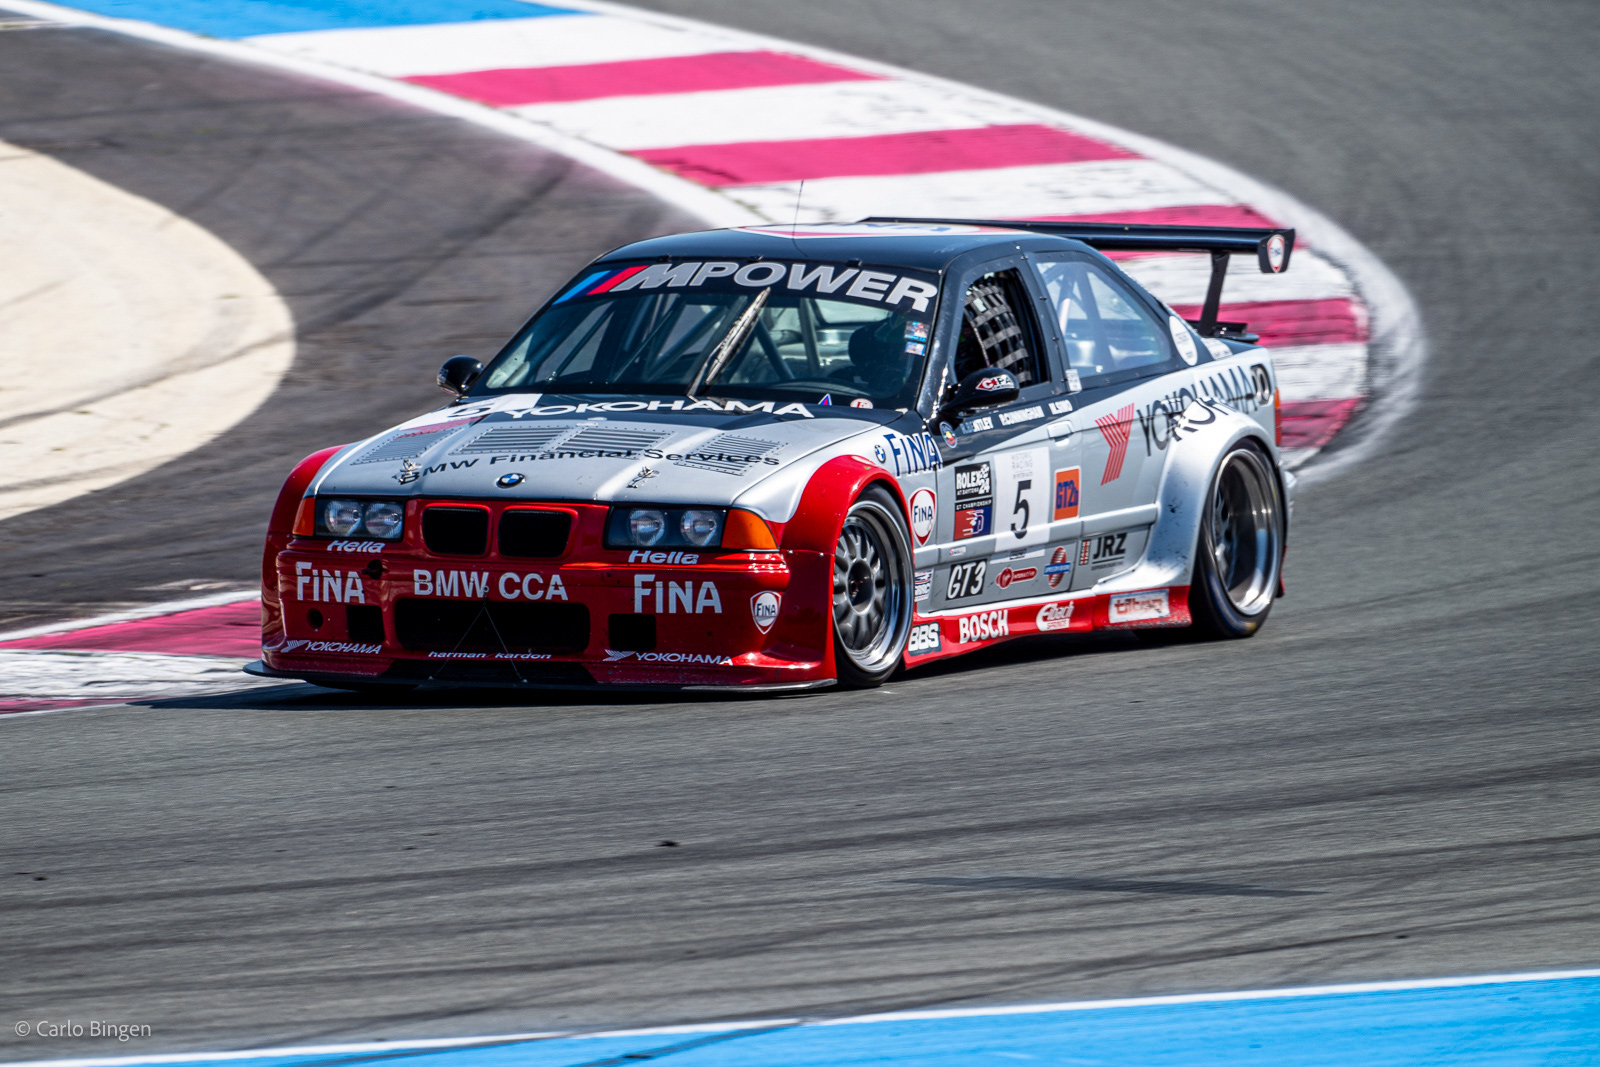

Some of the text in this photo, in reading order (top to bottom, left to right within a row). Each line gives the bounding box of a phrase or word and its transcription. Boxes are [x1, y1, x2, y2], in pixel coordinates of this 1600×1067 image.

[609, 261, 938, 313] MPOWER
[503, 399, 814, 419] YOKOHAMA
[400, 448, 780, 486] BMW Financial Services
[883, 432, 942, 477] FINA
[956, 471, 982, 490] ROLEX
[978, 478, 990, 494] 24
[913, 505, 934, 524] FINA
[1010, 479, 1032, 540] 5
[327, 540, 385, 553] Hella
[628, 550, 699, 565] Hella
[1093, 533, 1127, 559] JRZ
[296, 562, 365, 604] FINA
[413, 569, 569, 601] BMW CCA
[947, 560, 987, 599] GT3
[633, 574, 722, 614] FINA
[756, 603, 776, 617] FINA
[907, 622, 940, 652] BBS
[958, 610, 1009, 644] BOSCH
[304, 641, 383, 655] YOKOHAMA
[635, 652, 734, 666] YOKOHAMA
